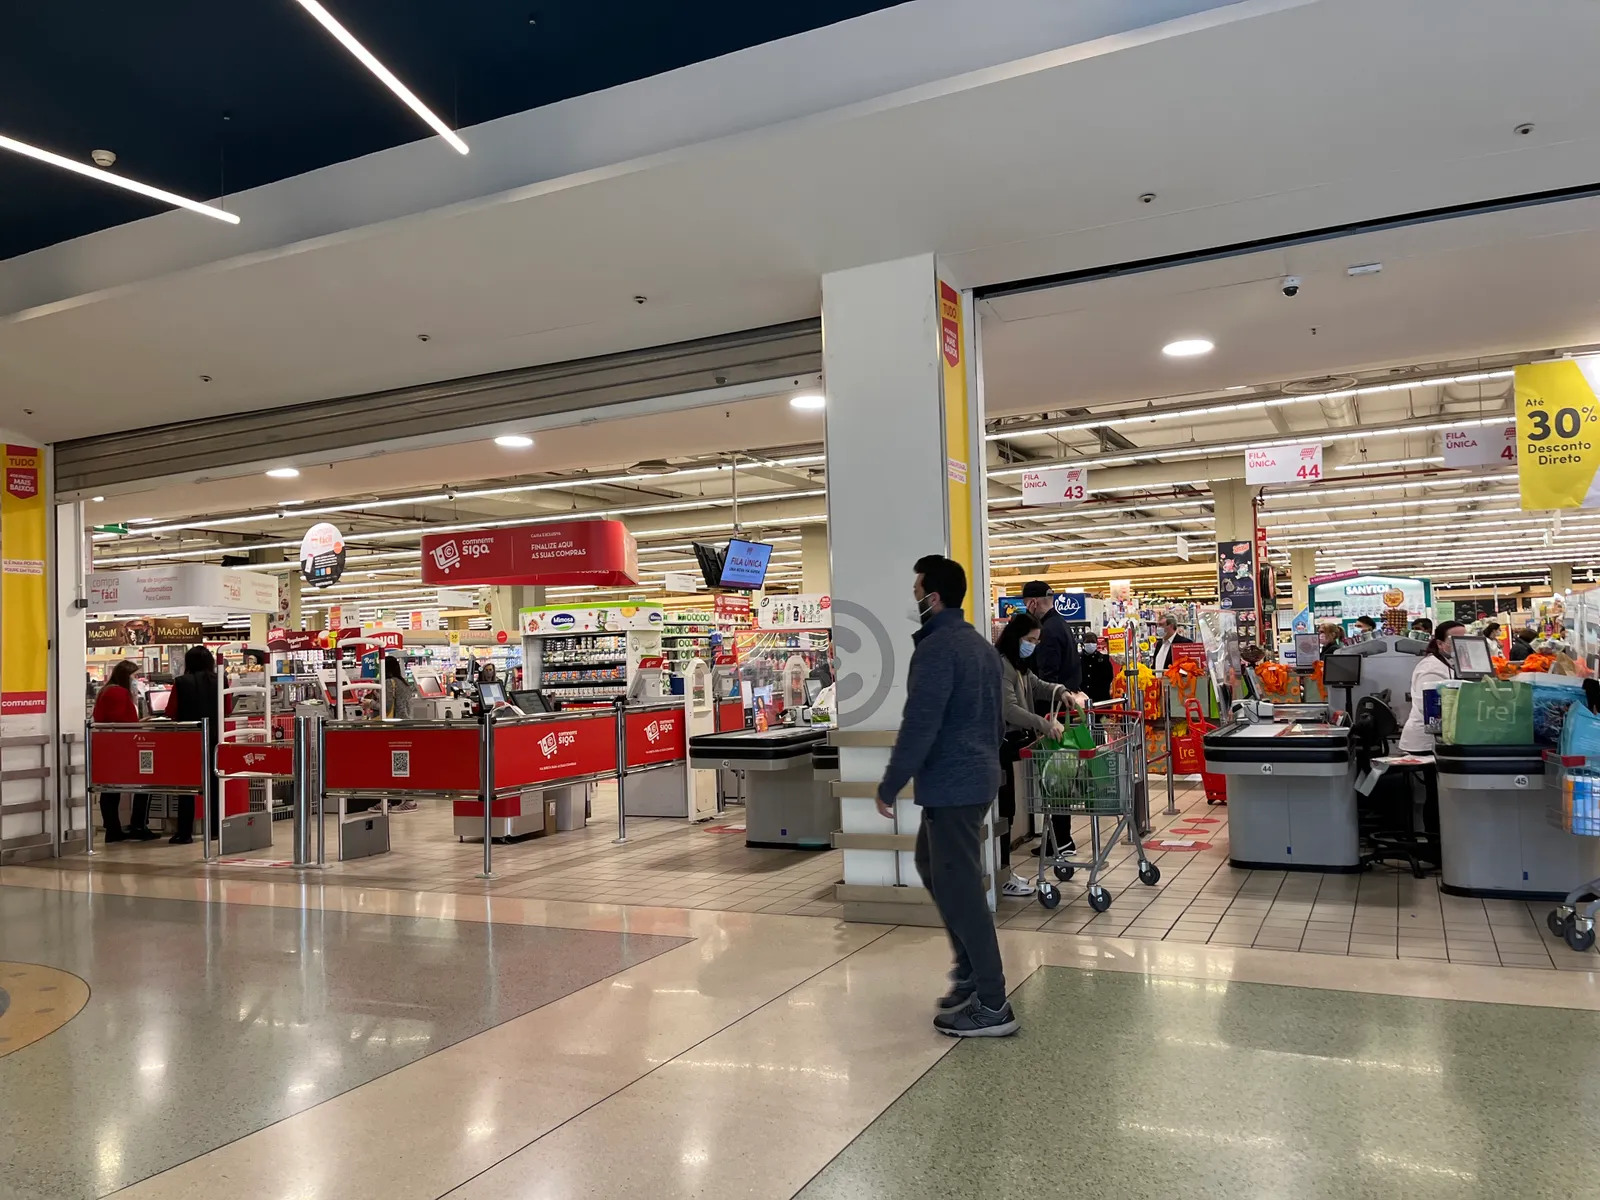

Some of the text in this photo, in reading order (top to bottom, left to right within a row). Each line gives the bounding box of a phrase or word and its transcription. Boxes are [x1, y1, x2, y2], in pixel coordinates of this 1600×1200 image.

[1525, 398, 1545, 407] Até
[1446, 432, 1467, 440] FILA
[1446, 440, 1478, 449] ÚNICA
[1528, 441, 1592, 454] Desconto
[1248, 452, 1267, 460] FILA
[1501, 445, 1517, 460] 4
[9, 458, 35, 467] TUDO
[1249, 459, 1276, 469] ÚNICA
[1538, 455, 1582, 465] Direto
[1296, 464, 1321, 480] 44
[9, 484, 35, 492] BAIXOS
[1024, 481, 1048, 489] ÚNICA
[1063, 485, 1084, 500] 43
[462, 543, 490, 558] siga
[531, 542, 557, 551] FINALIZE
[540, 551, 555, 559] SUAS
[555, 548, 586, 557] COMPRAS
[731, 557, 762, 568] FILA ÚNICA
[92, 577, 120, 588] compra
[101, 588, 118, 600] fácil
[143, 585, 173, 593] Automático
[88, 628, 117, 638] MAGNUM
[157, 627, 200, 636] MAGNUM
[268, 630, 284, 641] Royal
[558, 735, 576, 747] siga
[1515, 777, 1527, 785] 45
